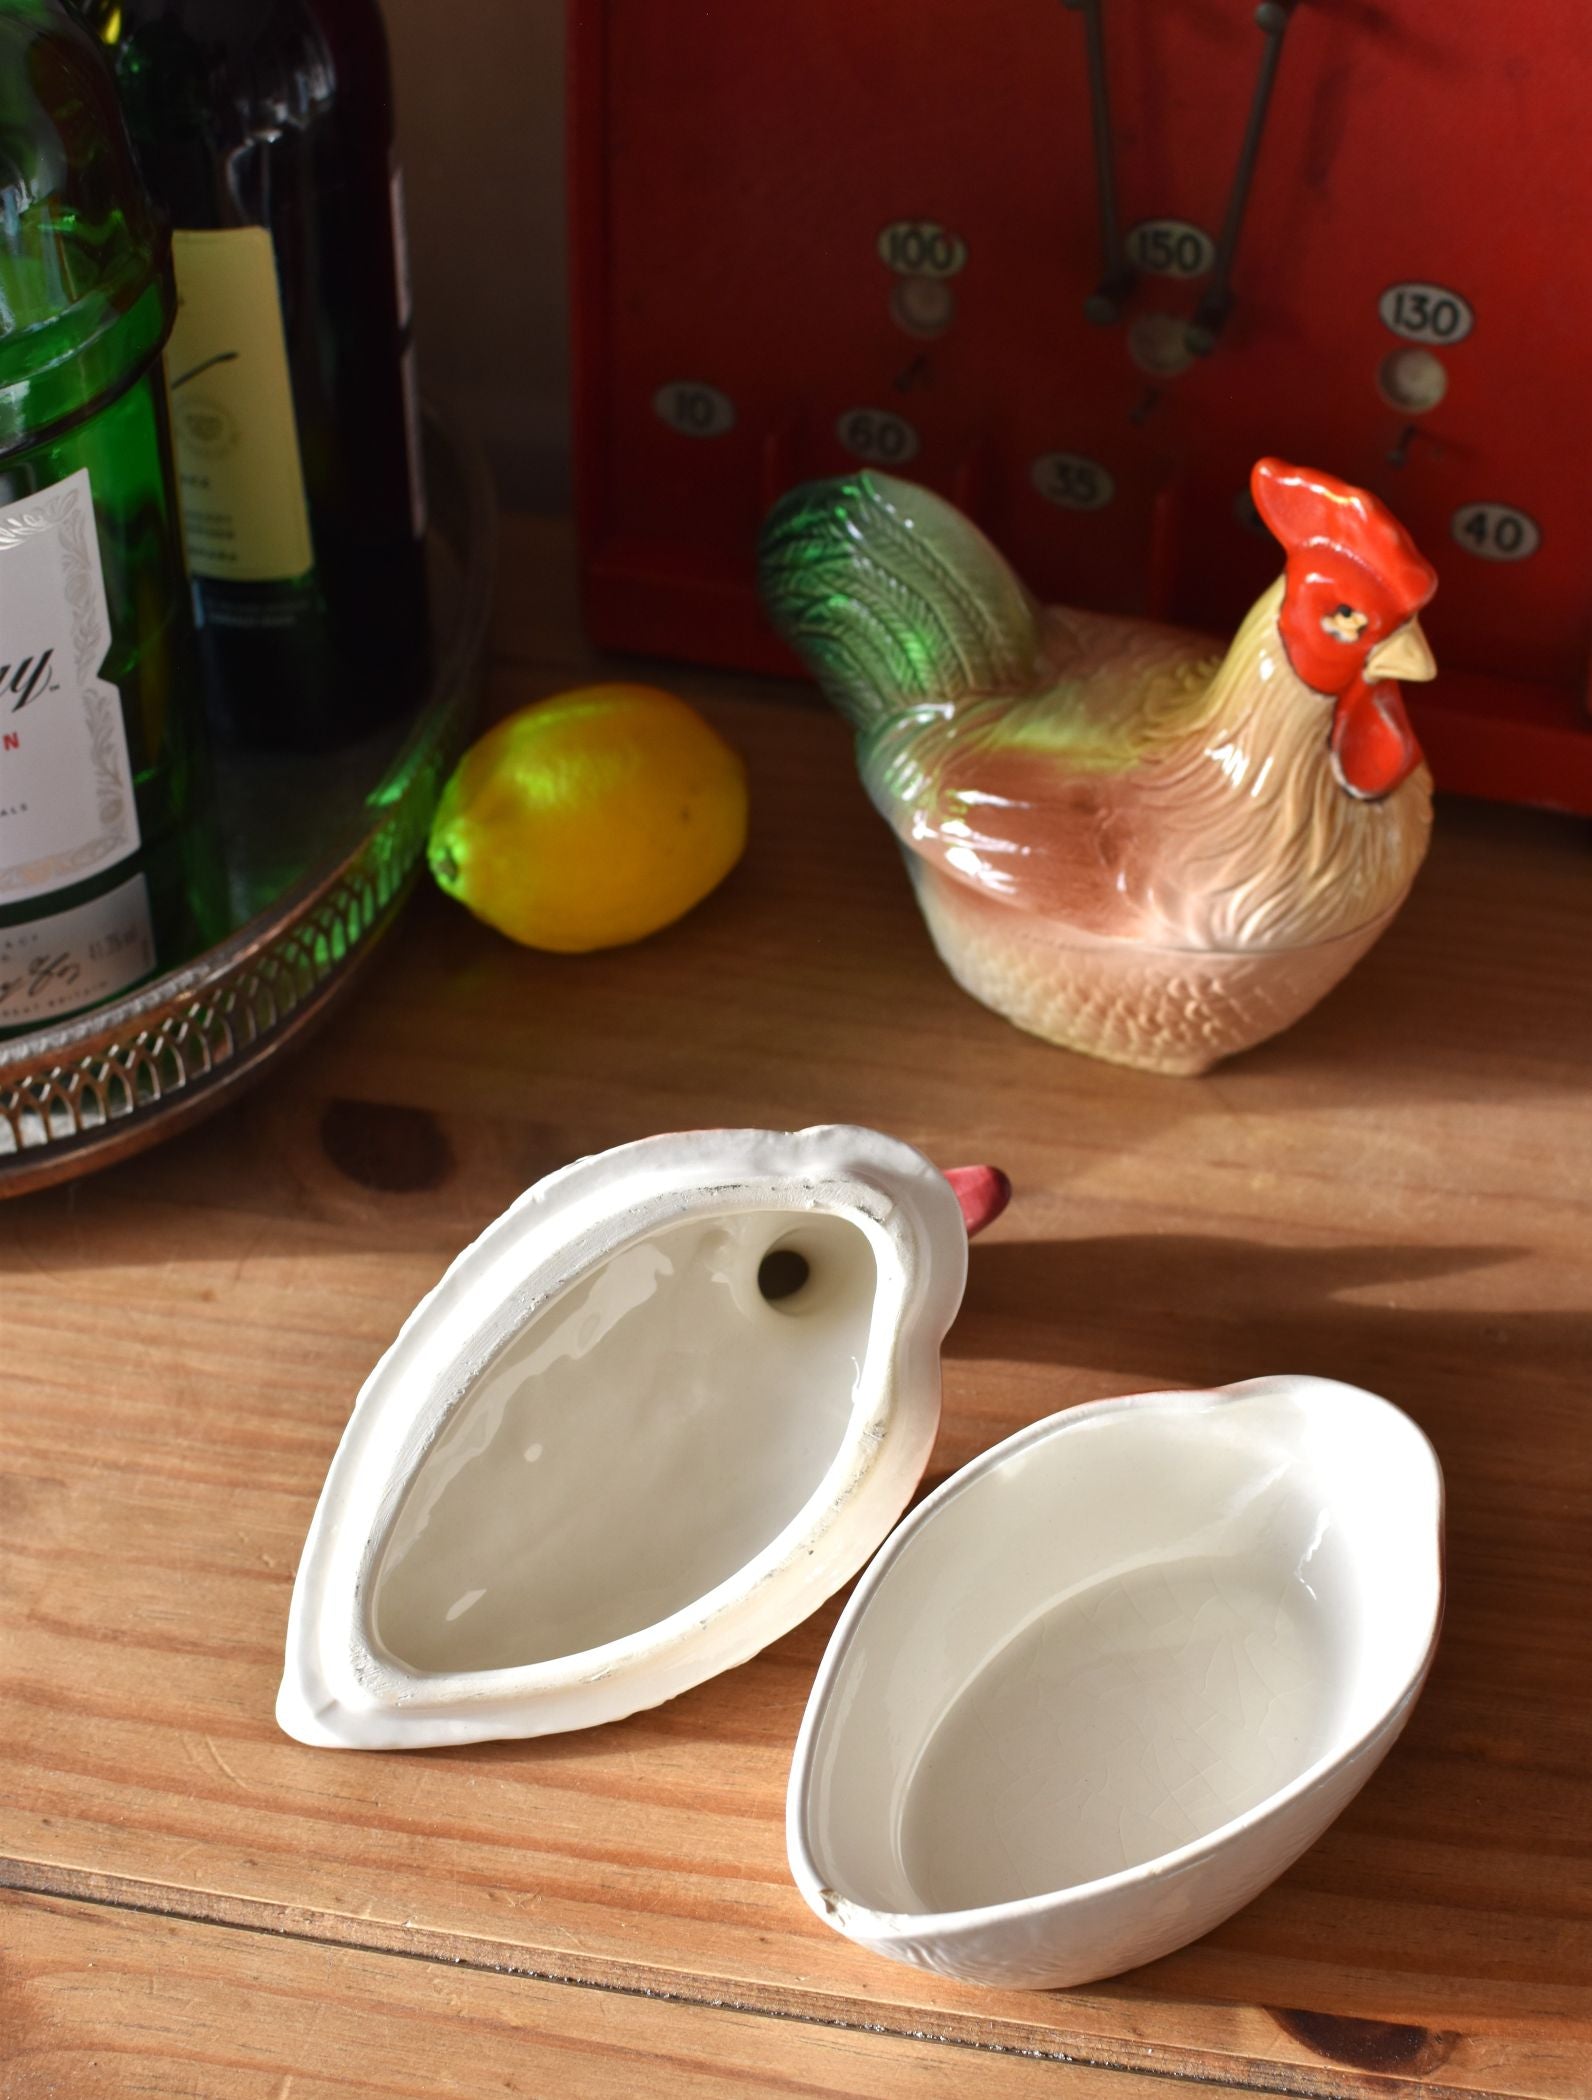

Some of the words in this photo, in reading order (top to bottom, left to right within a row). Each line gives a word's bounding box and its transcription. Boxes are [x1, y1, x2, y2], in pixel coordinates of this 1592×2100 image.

[889, 228, 955, 271] 100
[1138, 229, 1203, 271] 150
[1393, 290, 1460, 337] 130
[675, 389, 715, 427] 10
[848, 415, 907, 457] 60
[1045, 460, 1098, 503] 35
[1463, 510, 1524, 553] 40
